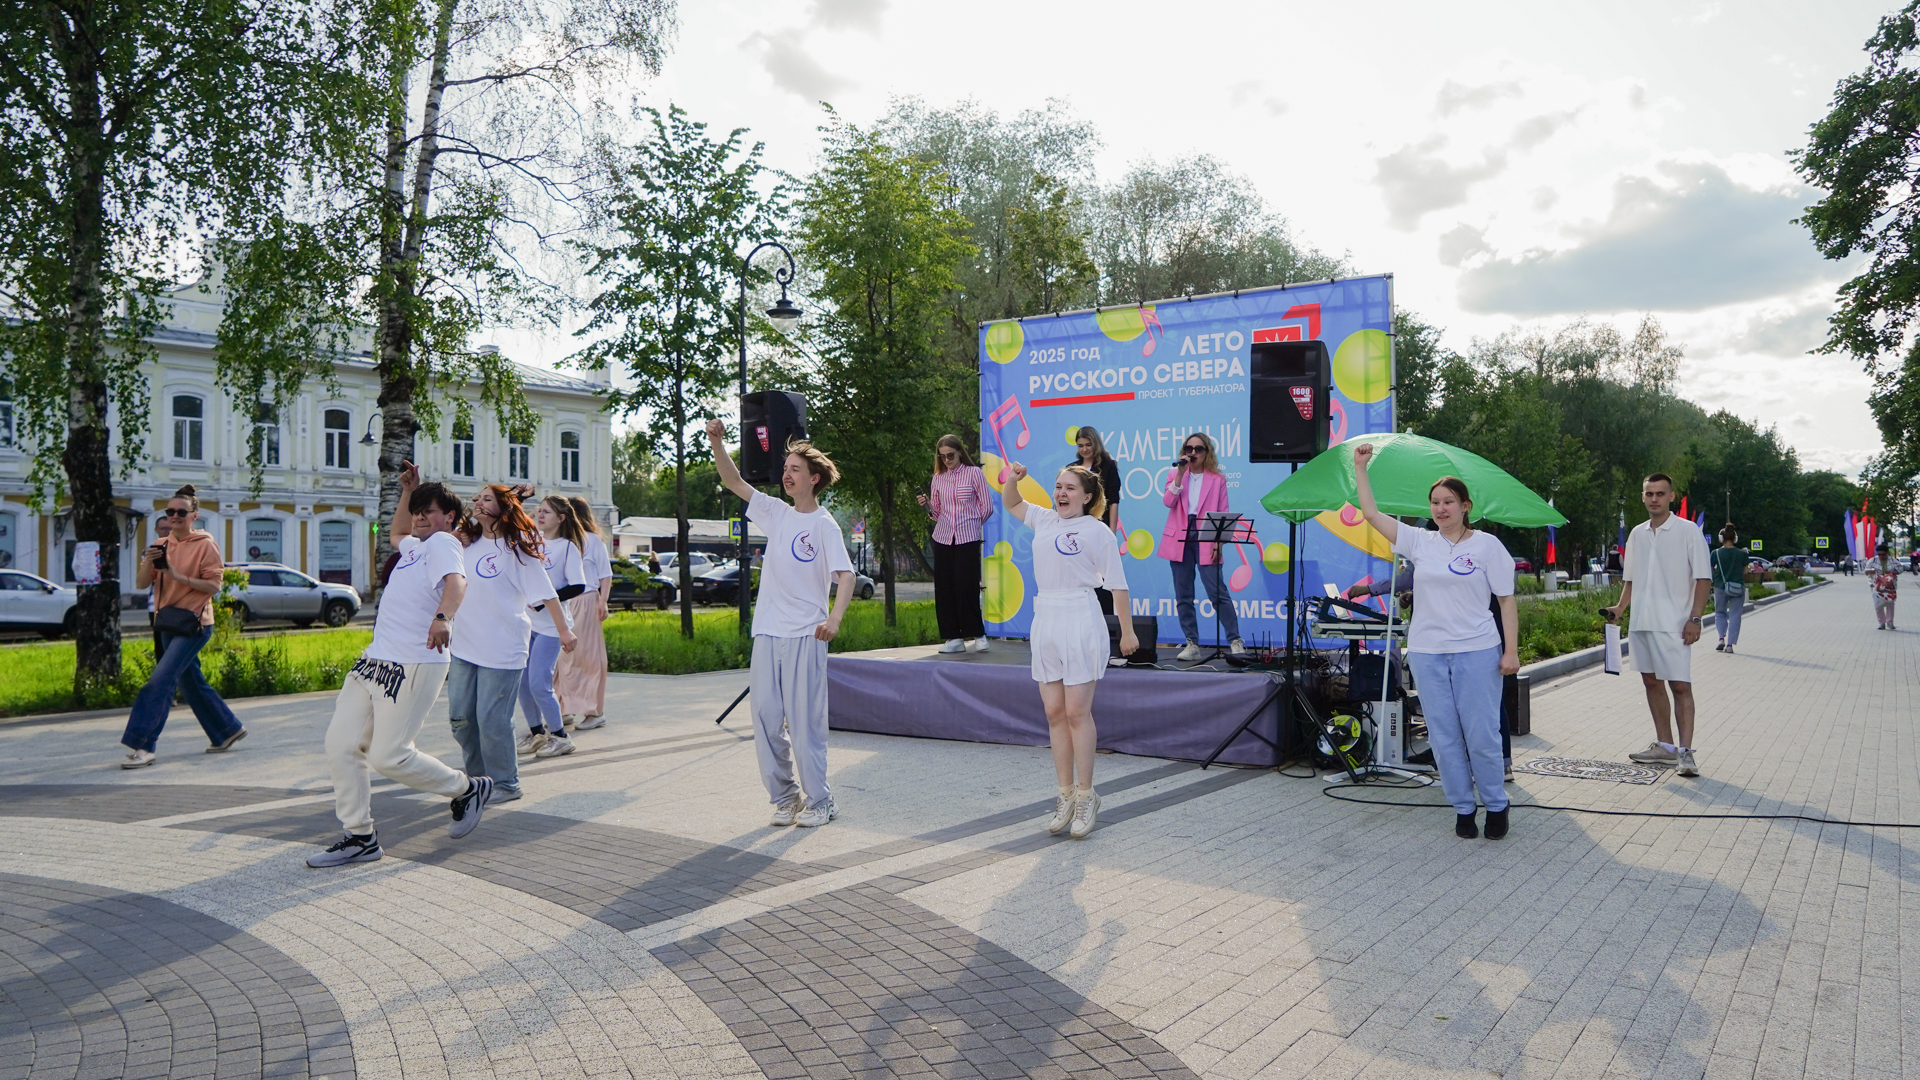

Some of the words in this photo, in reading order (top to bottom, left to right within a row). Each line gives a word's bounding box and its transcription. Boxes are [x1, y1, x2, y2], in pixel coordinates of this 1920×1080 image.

[1180, 331, 1244, 356] ЛЕТО
[1029, 348, 1066, 364] 2025
[1071, 347, 1100, 361] год
[1029, 366, 1147, 394] РУССКОГО
[1153, 357, 1245, 383] СЕВЕРА
[1138, 389, 1174, 400] ПРОЕКТ
[1179, 383, 1246, 397] ГУБЕРНАТОРА
